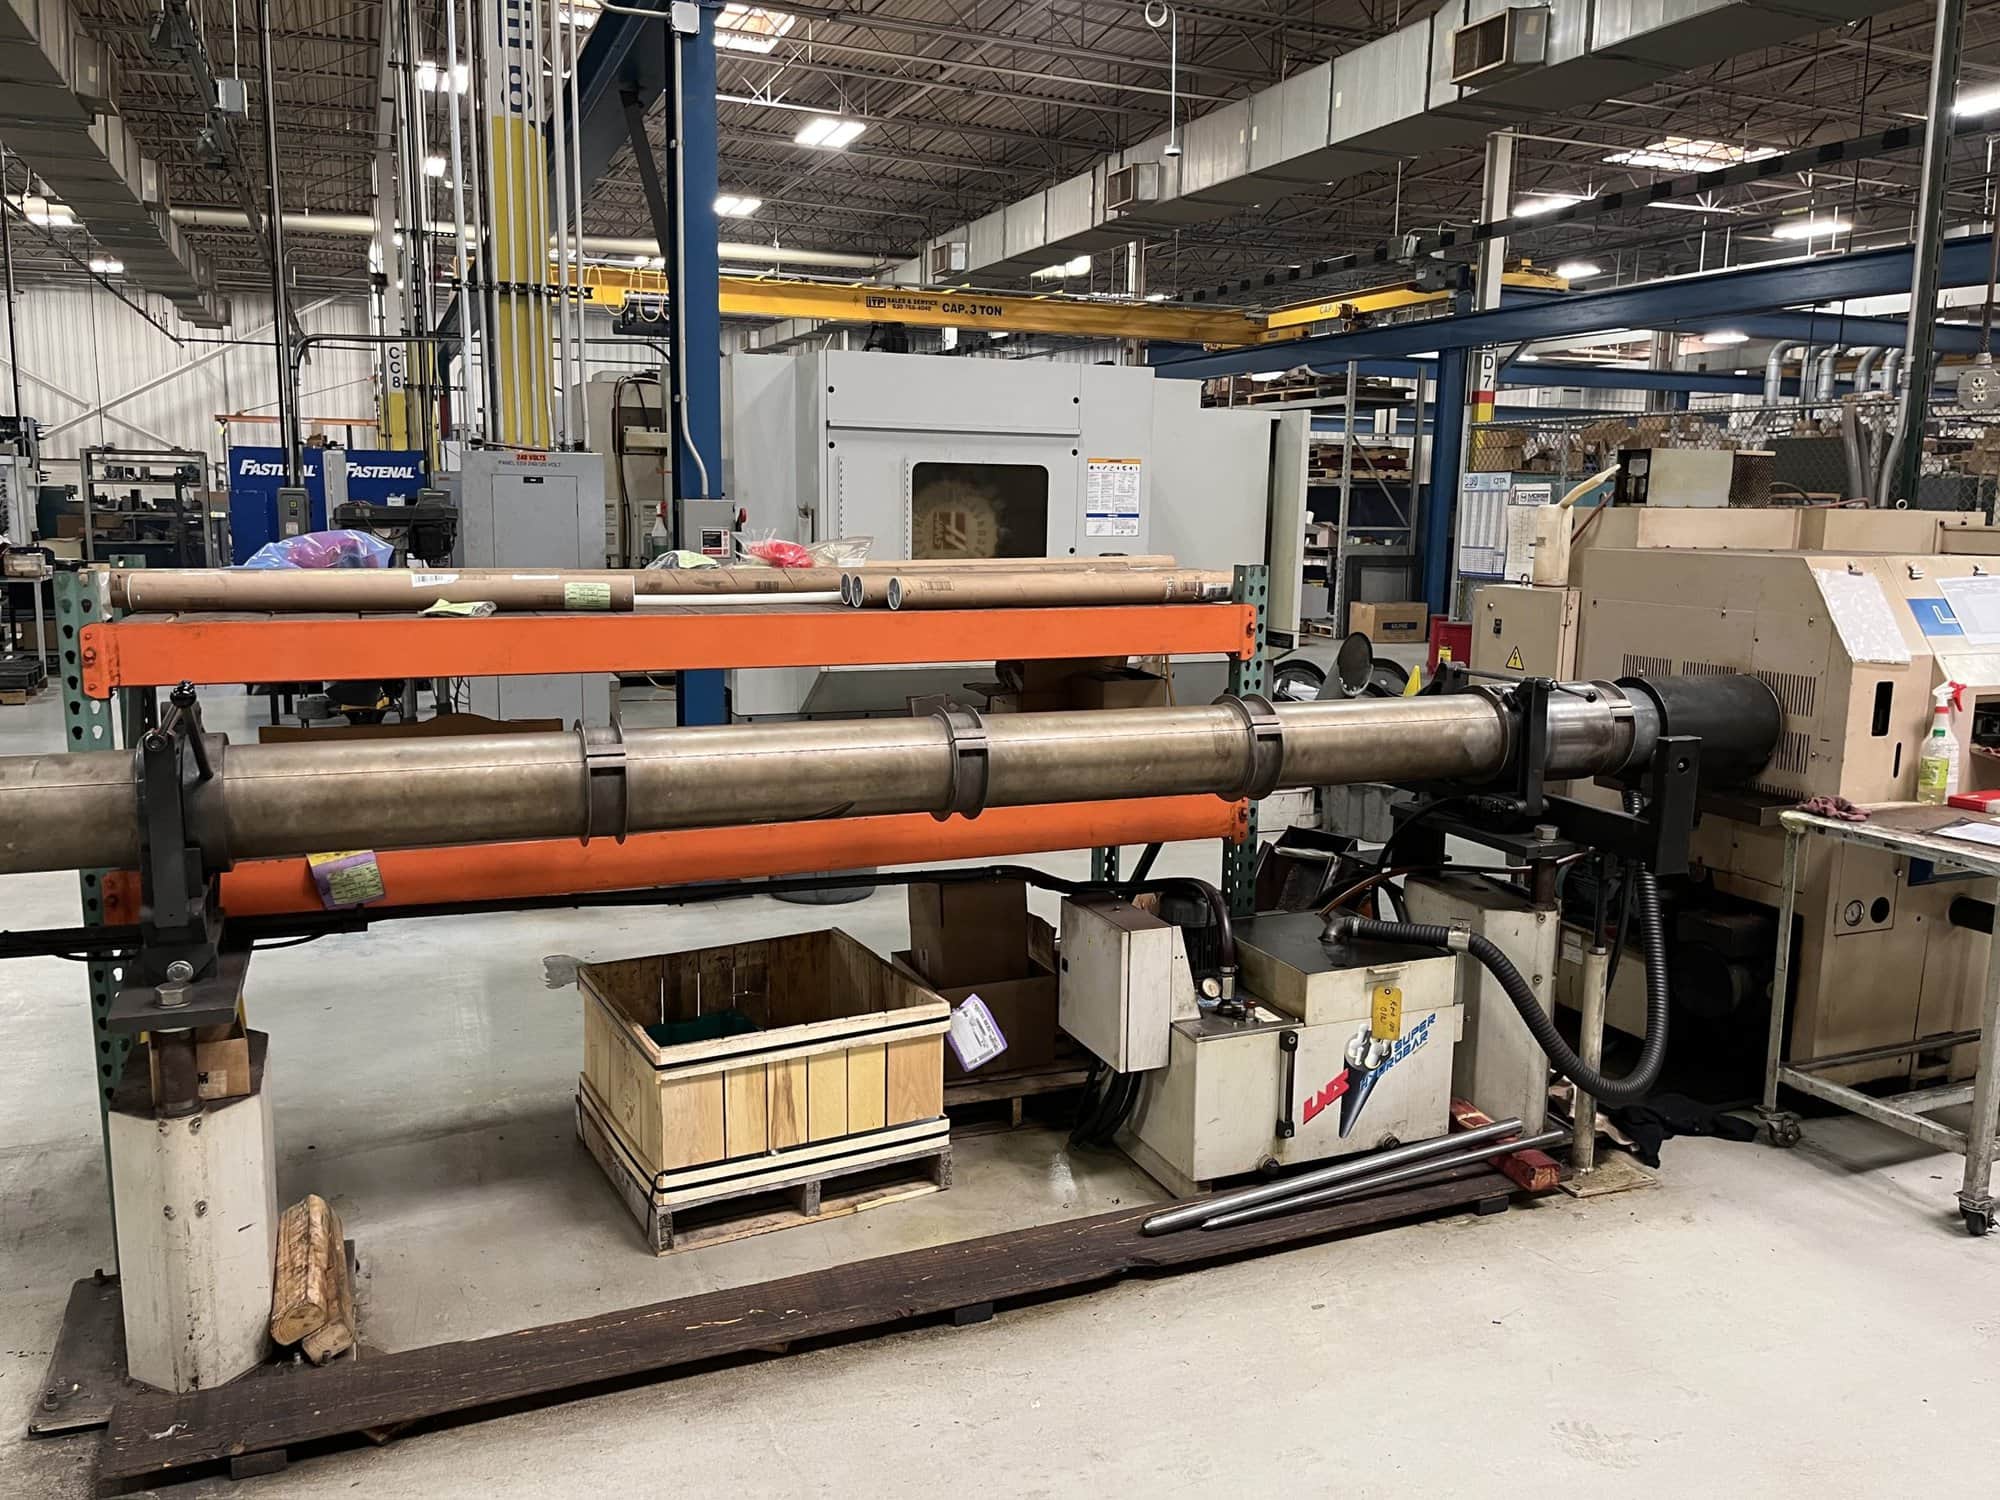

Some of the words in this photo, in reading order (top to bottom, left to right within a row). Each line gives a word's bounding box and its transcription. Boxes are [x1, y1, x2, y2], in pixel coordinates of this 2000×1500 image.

[942, 303, 968, 314] CAP.
[971, 304, 977, 315] 3
[980, 306, 1002, 316] TON
[239, 459, 316, 477] FASTL
[345, 462, 415, 479] FASTENAL
[1394, 1012, 1437, 1053] SUPER
[1303, 1067, 1351, 1125] LNS
